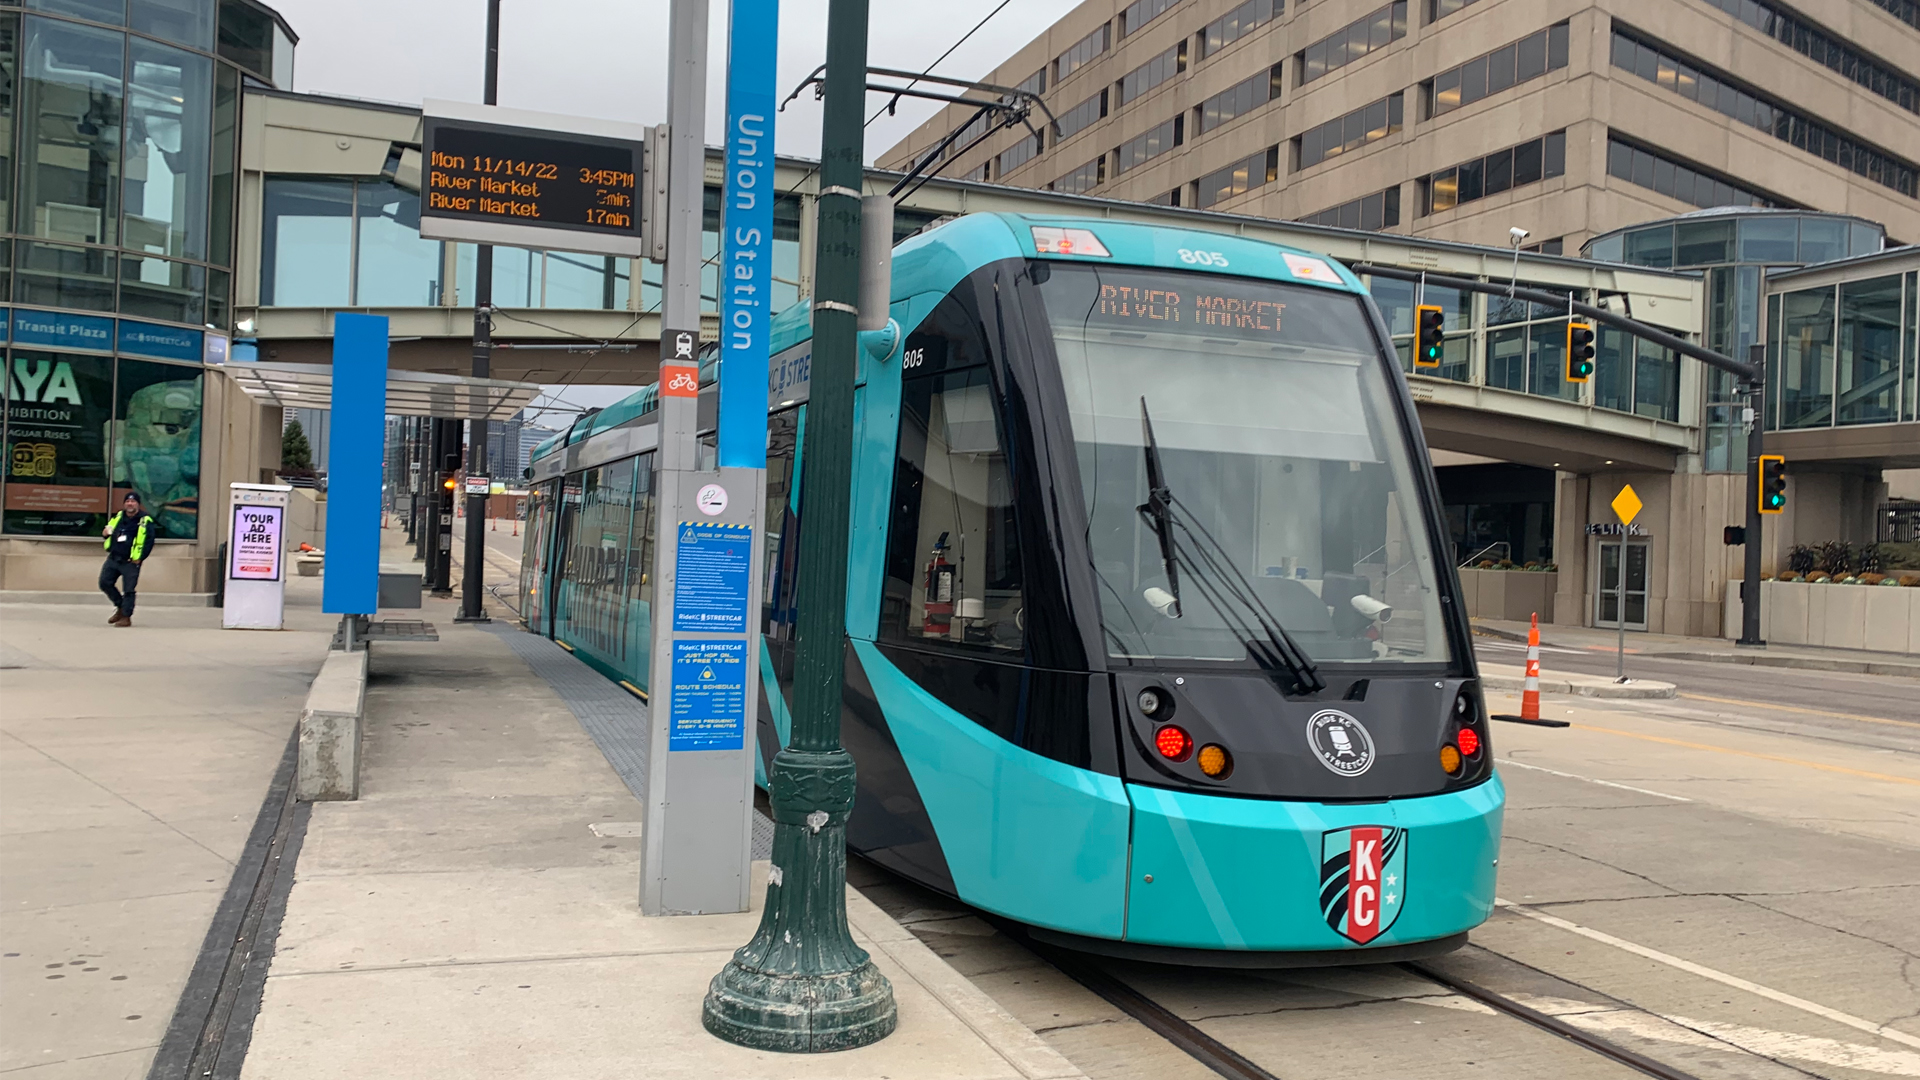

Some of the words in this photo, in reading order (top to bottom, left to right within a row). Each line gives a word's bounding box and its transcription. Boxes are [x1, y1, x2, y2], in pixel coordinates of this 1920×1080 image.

[431, 151, 465, 169] Mon
[473, 156, 557, 179] 11/14/22
[579, 167, 634, 188] 3:45PM
[737, 114, 764, 209] Union
[430, 171, 476, 190] River
[480, 176, 541, 197] Market
[430, 192, 476, 210] River
[479, 197, 540, 217] Market
[586, 209, 630, 226] 17min
[1178, 248, 1229, 267] 805
[733, 227, 761, 350] Station
[1101, 284, 1180, 321] RIVER
[1195, 295, 1286, 331] MARKET
[16, 320, 66, 335] Transit
[69, 324, 107, 339] Plaza
[145, 334, 191, 347] STREETCAR
[903, 348, 924, 369] 805
[787, 354, 811, 387] STRE
[243, 513, 274, 524] YOUR
[249, 524, 266, 533] AD
[242, 533, 272, 544] HERE
[1316, 715, 1336, 728] RIDE
[1338, 717, 1352, 728] KC
[1324, 751, 1369, 770] STREETCAR
[1354, 839, 1377, 927] KC
